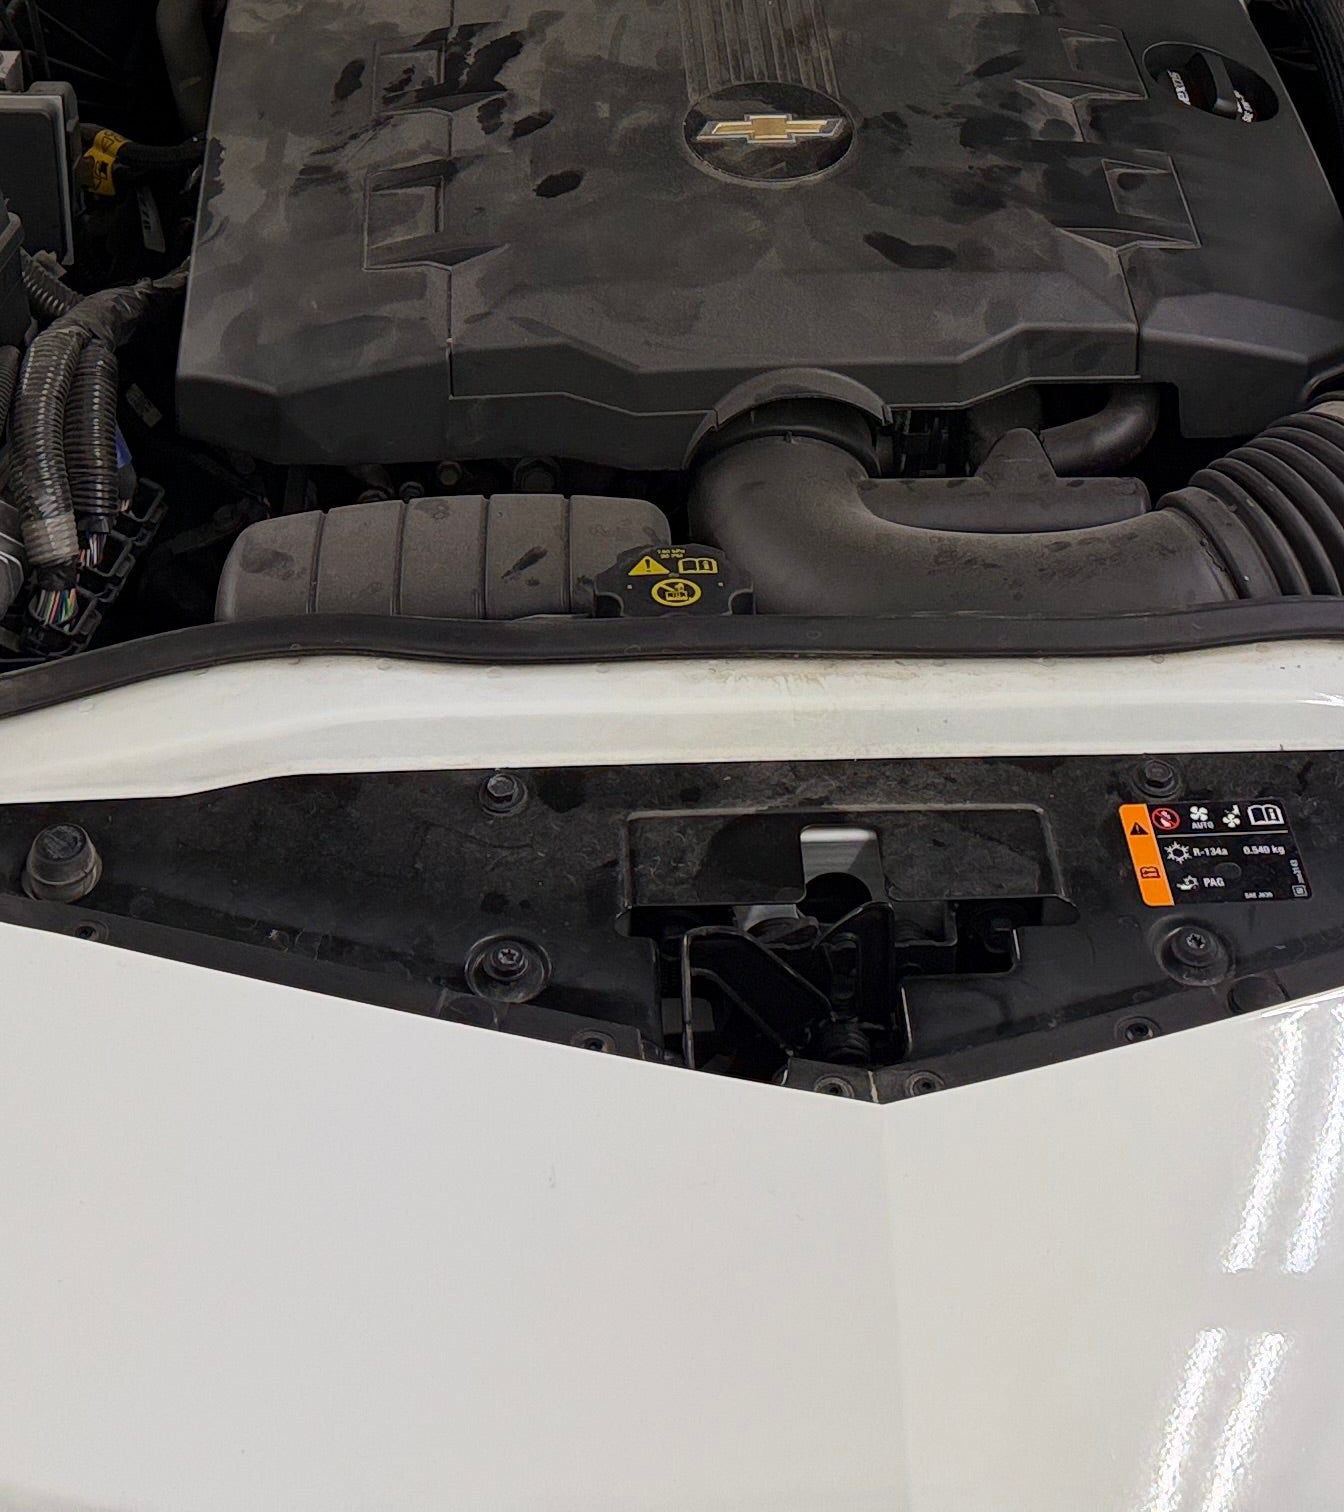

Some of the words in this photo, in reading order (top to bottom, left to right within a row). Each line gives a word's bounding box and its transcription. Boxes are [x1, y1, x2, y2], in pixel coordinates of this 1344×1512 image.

[1191, 821, 1214, 830] AUTO
[1192, 847, 1229, 857] R-134a
[1242, 845, 1270, 855] 0.540
[1271, 844, 1285, 855] kg
[1203, 877, 1225, 887] PAG
